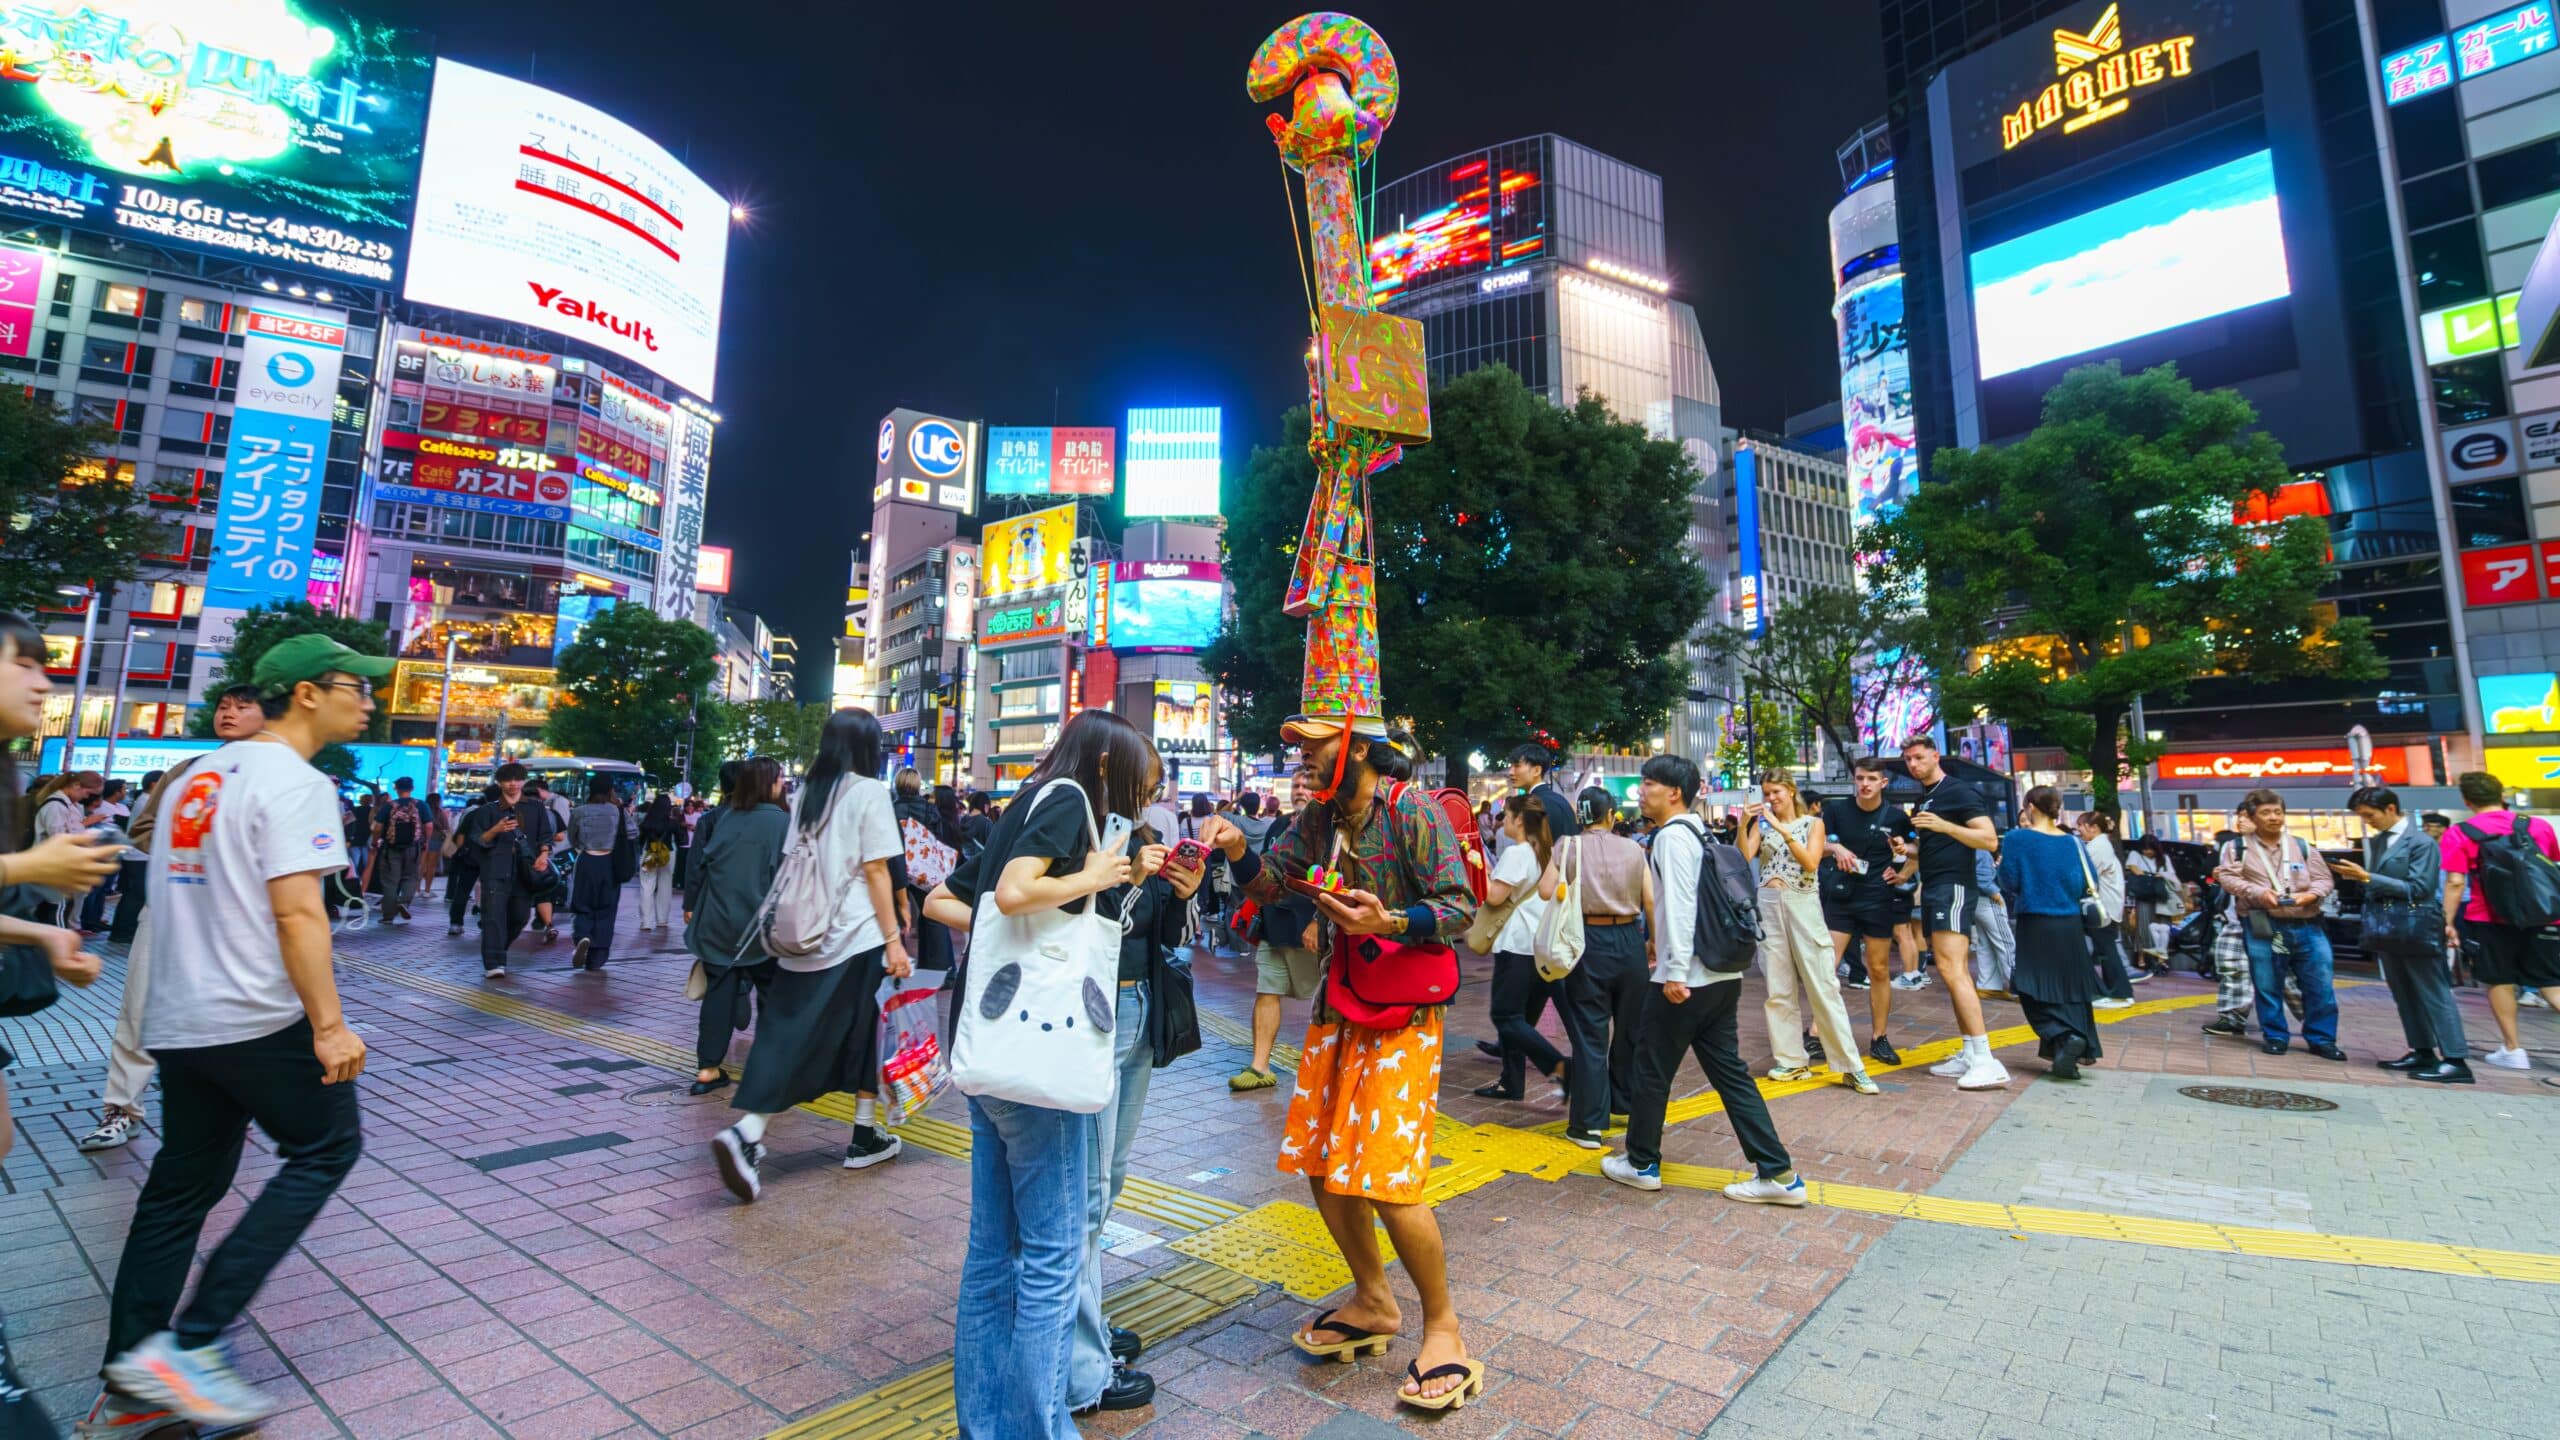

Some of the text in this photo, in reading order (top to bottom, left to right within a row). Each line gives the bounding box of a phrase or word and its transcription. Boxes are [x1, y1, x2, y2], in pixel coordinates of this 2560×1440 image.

[2391, 31, 2551, 100] 居酒屋 7F
[2003, 36, 2194, 149] MAGNET
[120, 184, 223, 226] 10月6日
[527, 281, 658, 352] Yakult
[398, 354, 425, 371] 9F
[471, 365, 545, 393] しゃぶ葉
[249, 387, 323, 410] eyecity
[424, 405, 541, 438] プライス
[497, 447, 557, 472] ガスト
[579, 430, 647, 472] コンタクト
[382, 459, 413, 477] 7F
[455, 467, 528, 496] ガスト
[224, 434, 282, 578] アイシティ
[268, 441, 315, 582] コンタクトの
[944, 491, 966, 502] VISA
[1067, 541, 1088, 628] もんじゃ
[1143, 562, 1189, 578] Rakuten
[1741, 575, 1758, 631] SEIBU
[2213, 757, 2264, 777] Cozy
[2265, 757, 2333, 773] Corner
